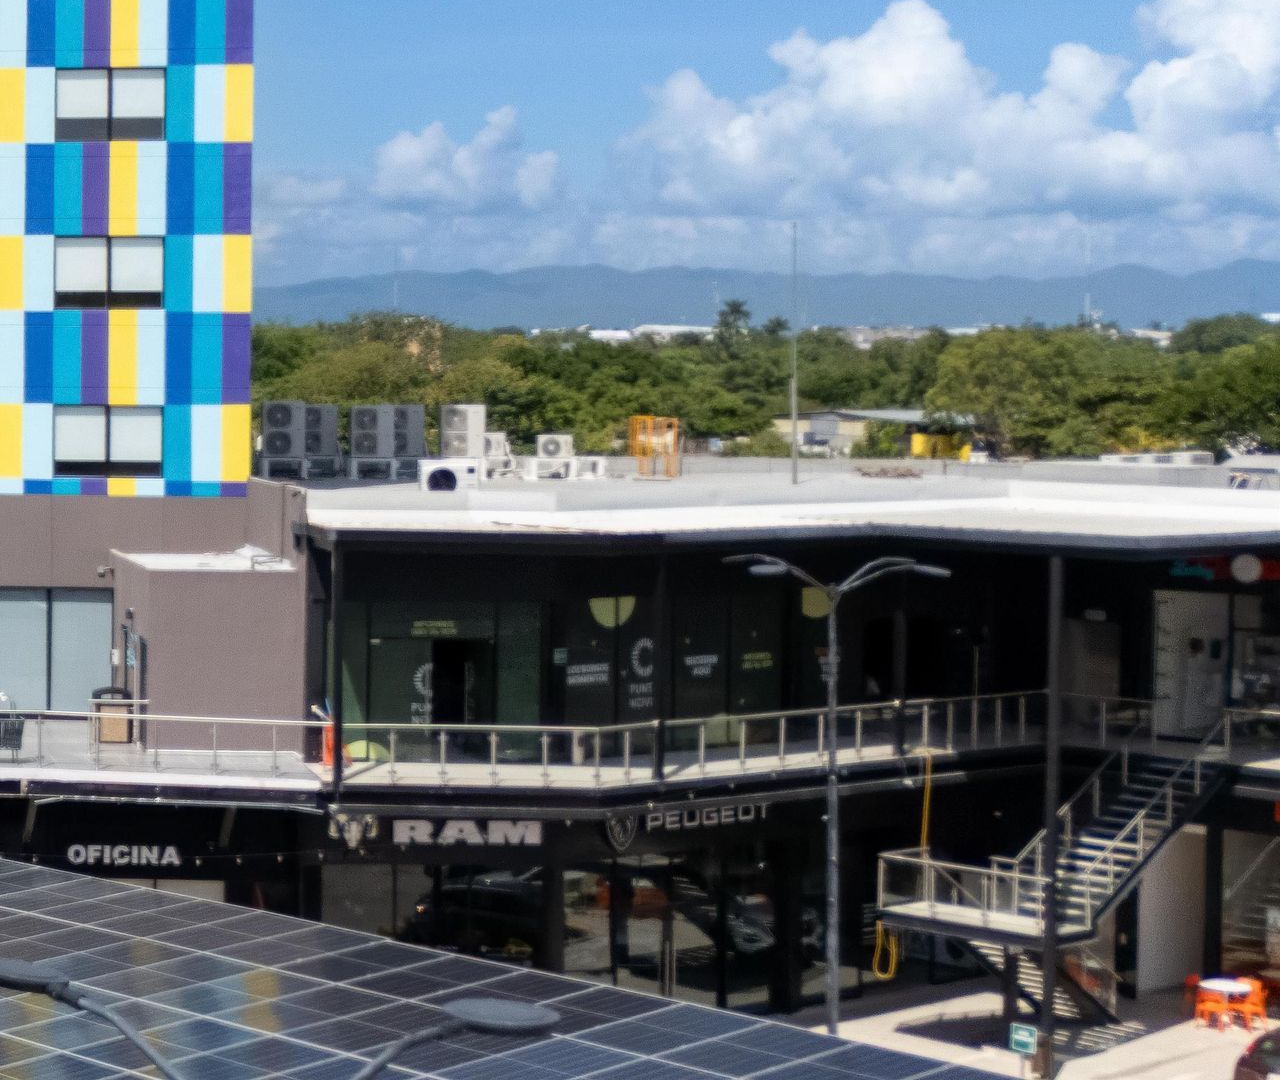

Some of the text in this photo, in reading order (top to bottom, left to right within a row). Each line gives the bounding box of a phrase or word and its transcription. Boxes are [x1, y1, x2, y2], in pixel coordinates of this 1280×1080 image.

[646, 802, 770, 832] PEUGEOT
[392, 819, 543, 846] RAM
[67, 844, 181, 865] OFICINA
